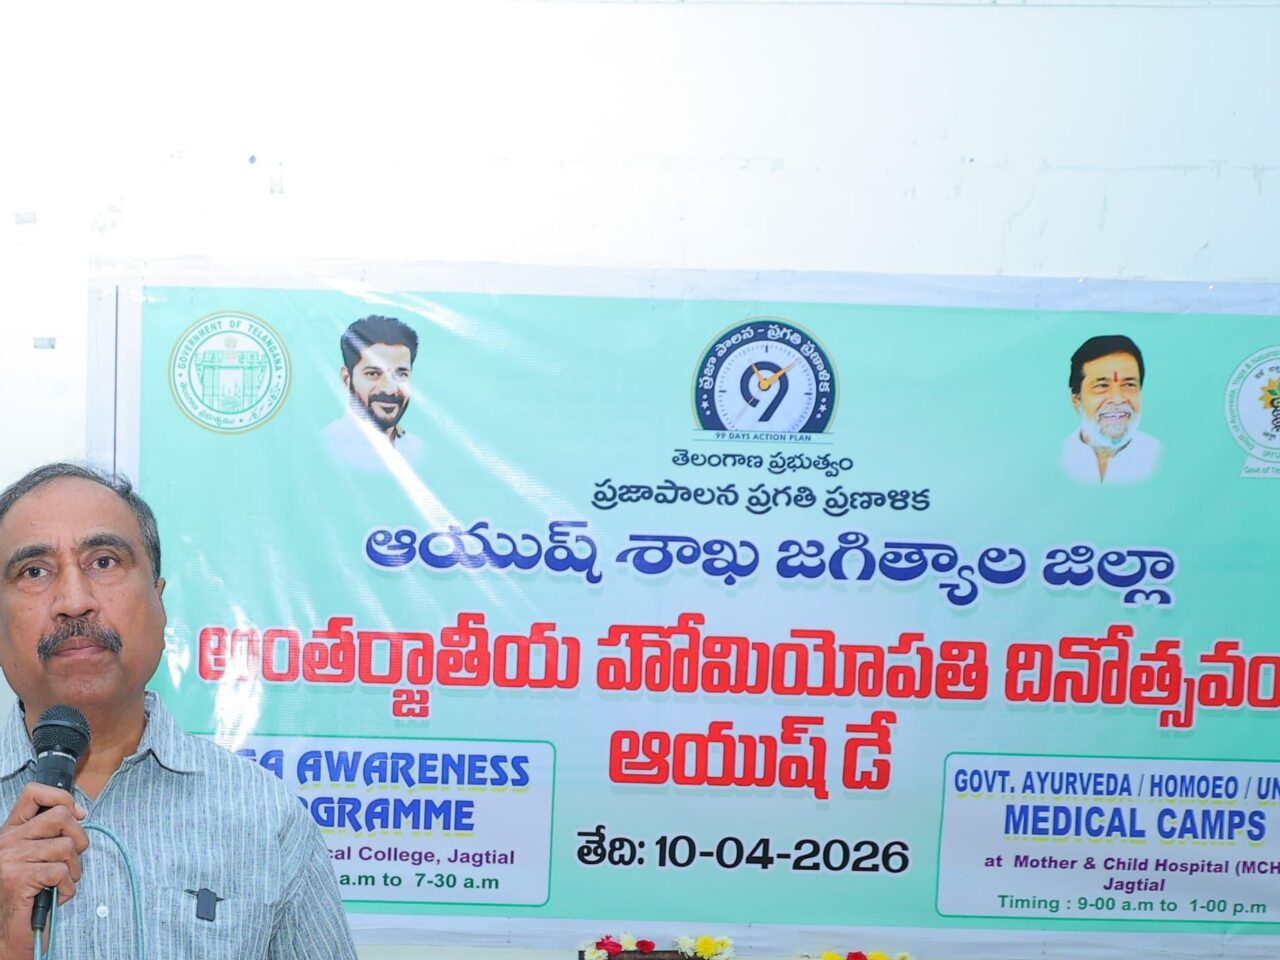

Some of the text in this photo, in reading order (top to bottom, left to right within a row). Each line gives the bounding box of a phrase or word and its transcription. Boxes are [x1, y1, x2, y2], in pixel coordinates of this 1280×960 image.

[178, 320, 283, 371] GOVERNMENT OF TELANGANA
[767, 324, 802, 345] ప్రగతి
[715, 432, 812, 442] 99 DAYS ACTION PLAN
[671, 448, 854, 478] తెలంగాణ ప్రభుత్వం
[591, 478, 931, 517] ప్రజాపాలన ప్రగతి ప్రణాళిక
[365, 521, 1176, 606] ఆయుష్ శాఖ జగిత్యాల జిల్లా
[198, 612, 581, 718] అంతర్జాతీయ
[596, 612, 989, 700] హోమియోపతి
[297, 751, 530, 788] AWARENESS
[609, 710, 898, 800] ఆయుష్ డే
[954, 769, 1016, 794] GOVT.
[1022, 771, 1132, 796] AYURVEDA
[1150, 774, 1239, 799] HOMOEO
[1257, 777, 1280, 800] UN
[298, 797, 474, 832] GRAMME
[1004, 804, 1267, 841] MEDICAL CAMPS
[358, 846, 441, 866] College,
[447, 848, 515, 868] Jagtial
[655, 835, 910, 873] 10-04-2026
[984, 855, 1280, 877] at Mother & Child Hospital (MCH
[339, 873, 500, 890] a.m to 7-30 a.m
[1102, 877, 1166, 895] Jagtial
[998, 894, 1060, 913] Timing
[1077, 896, 1116, 911] 9-00
[1122, 899, 1154, 912] a.m
[1160, 898, 1178, 912] to
[1190, 899, 1227, 913] 1-00
[1232, 902, 1267, 916] p.m
